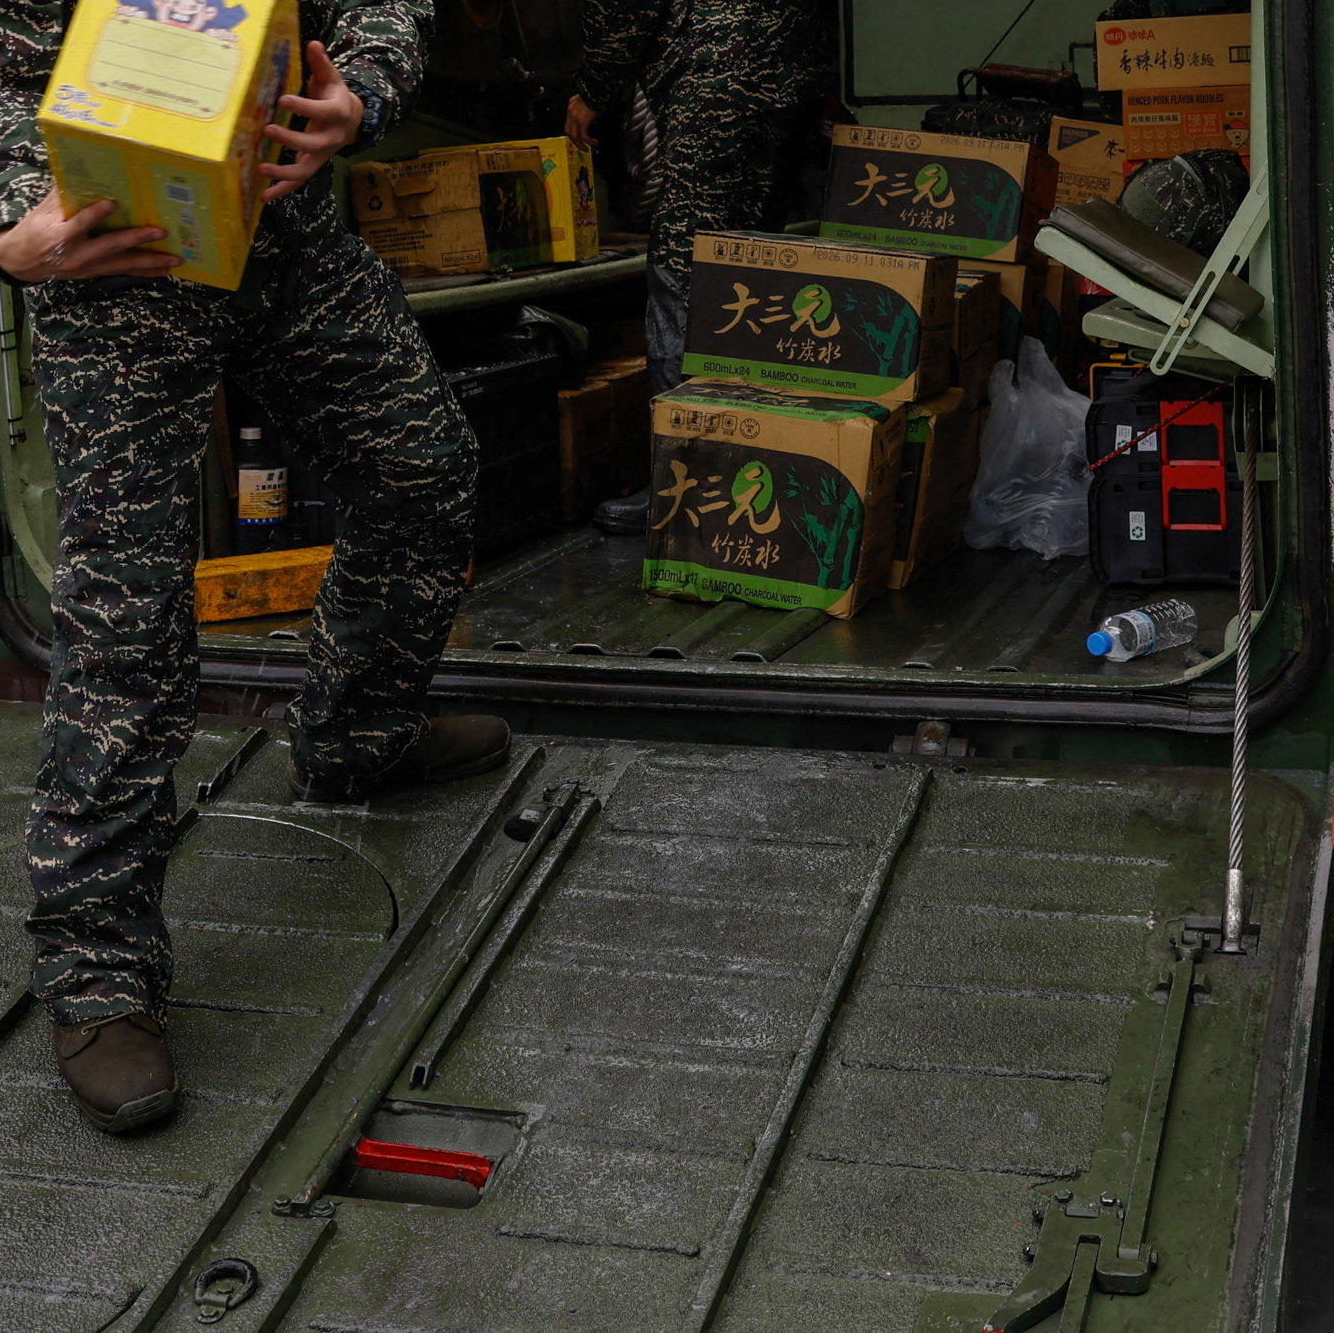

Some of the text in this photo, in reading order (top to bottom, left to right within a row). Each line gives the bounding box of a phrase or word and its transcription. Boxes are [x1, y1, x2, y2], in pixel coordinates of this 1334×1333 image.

[1127, 93, 1224, 106] MINCED PORK FLAVOR NOODLES
[847, 162, 956, 209] 大三元
[900, 208, 956, 231] 竹炭水
[885, 235, 918, 248] BAMBOO
[714, 282, 842, 338] 大三元
[776, 336, 842, 364] 竹炭水
[703, 361, 857, 390] 600mLx24 BAMBOO CHARCOAL WATER
[652, 459, 782, 535] 大三元
[711, 532, 780, 571] 竹炭水
[702, 577, 743, 596] BAMBOO
[744, 587, 779, 602] CHARCOAL
[779, 590, 803, 606] WATER
